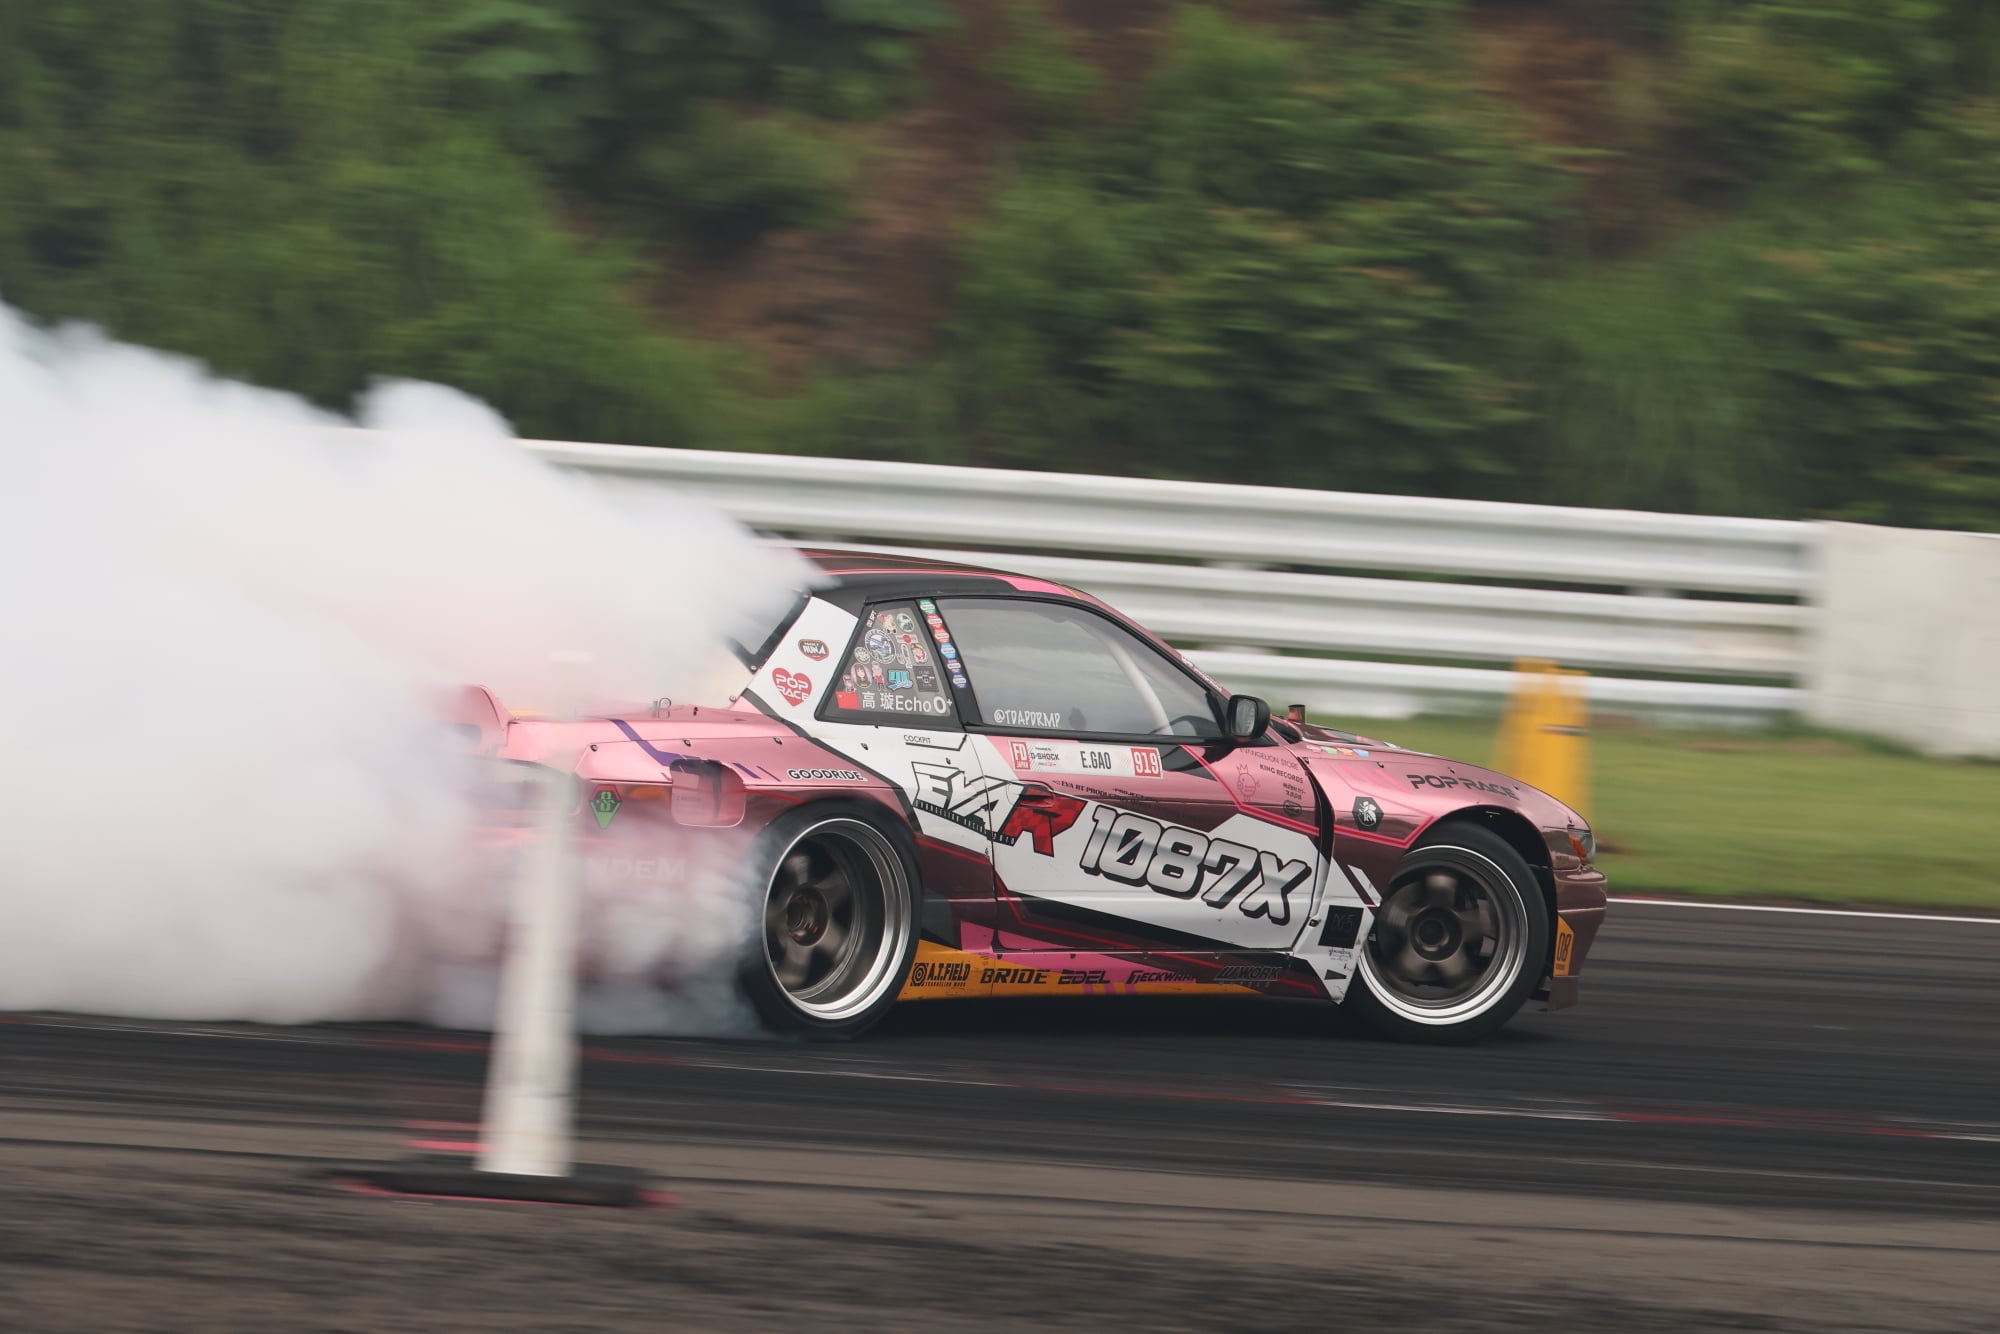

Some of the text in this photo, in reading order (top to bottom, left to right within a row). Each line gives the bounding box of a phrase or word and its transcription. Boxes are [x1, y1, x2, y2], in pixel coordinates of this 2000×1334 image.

[775, 674, 809, 689] POP
[777, 685, 809, 701] RACE
[896, 695, 932, 712] Echo
[903, 735, 931, 744] COCKPIT
[1013, 742, 1028, 761] FD
[1030, 752, 1060, 761] G-SHOCK
[1015, 761, 1030, 769] JAPAN
[1080, 751, 1112, 769] E.GAO
[1133, 750, 1160, 774] 919
[787, 769, 866, 781] GOODRIDE
[1259, 764, 1304, 784] KING RECORDS
[1079, 804, 1313, 926] 1087X
[926, 962, 971, 982] A.T.FIELD
[980, 968, 1051, 984] BRIDE
[1057, 969, 1111, 985] EDEL
